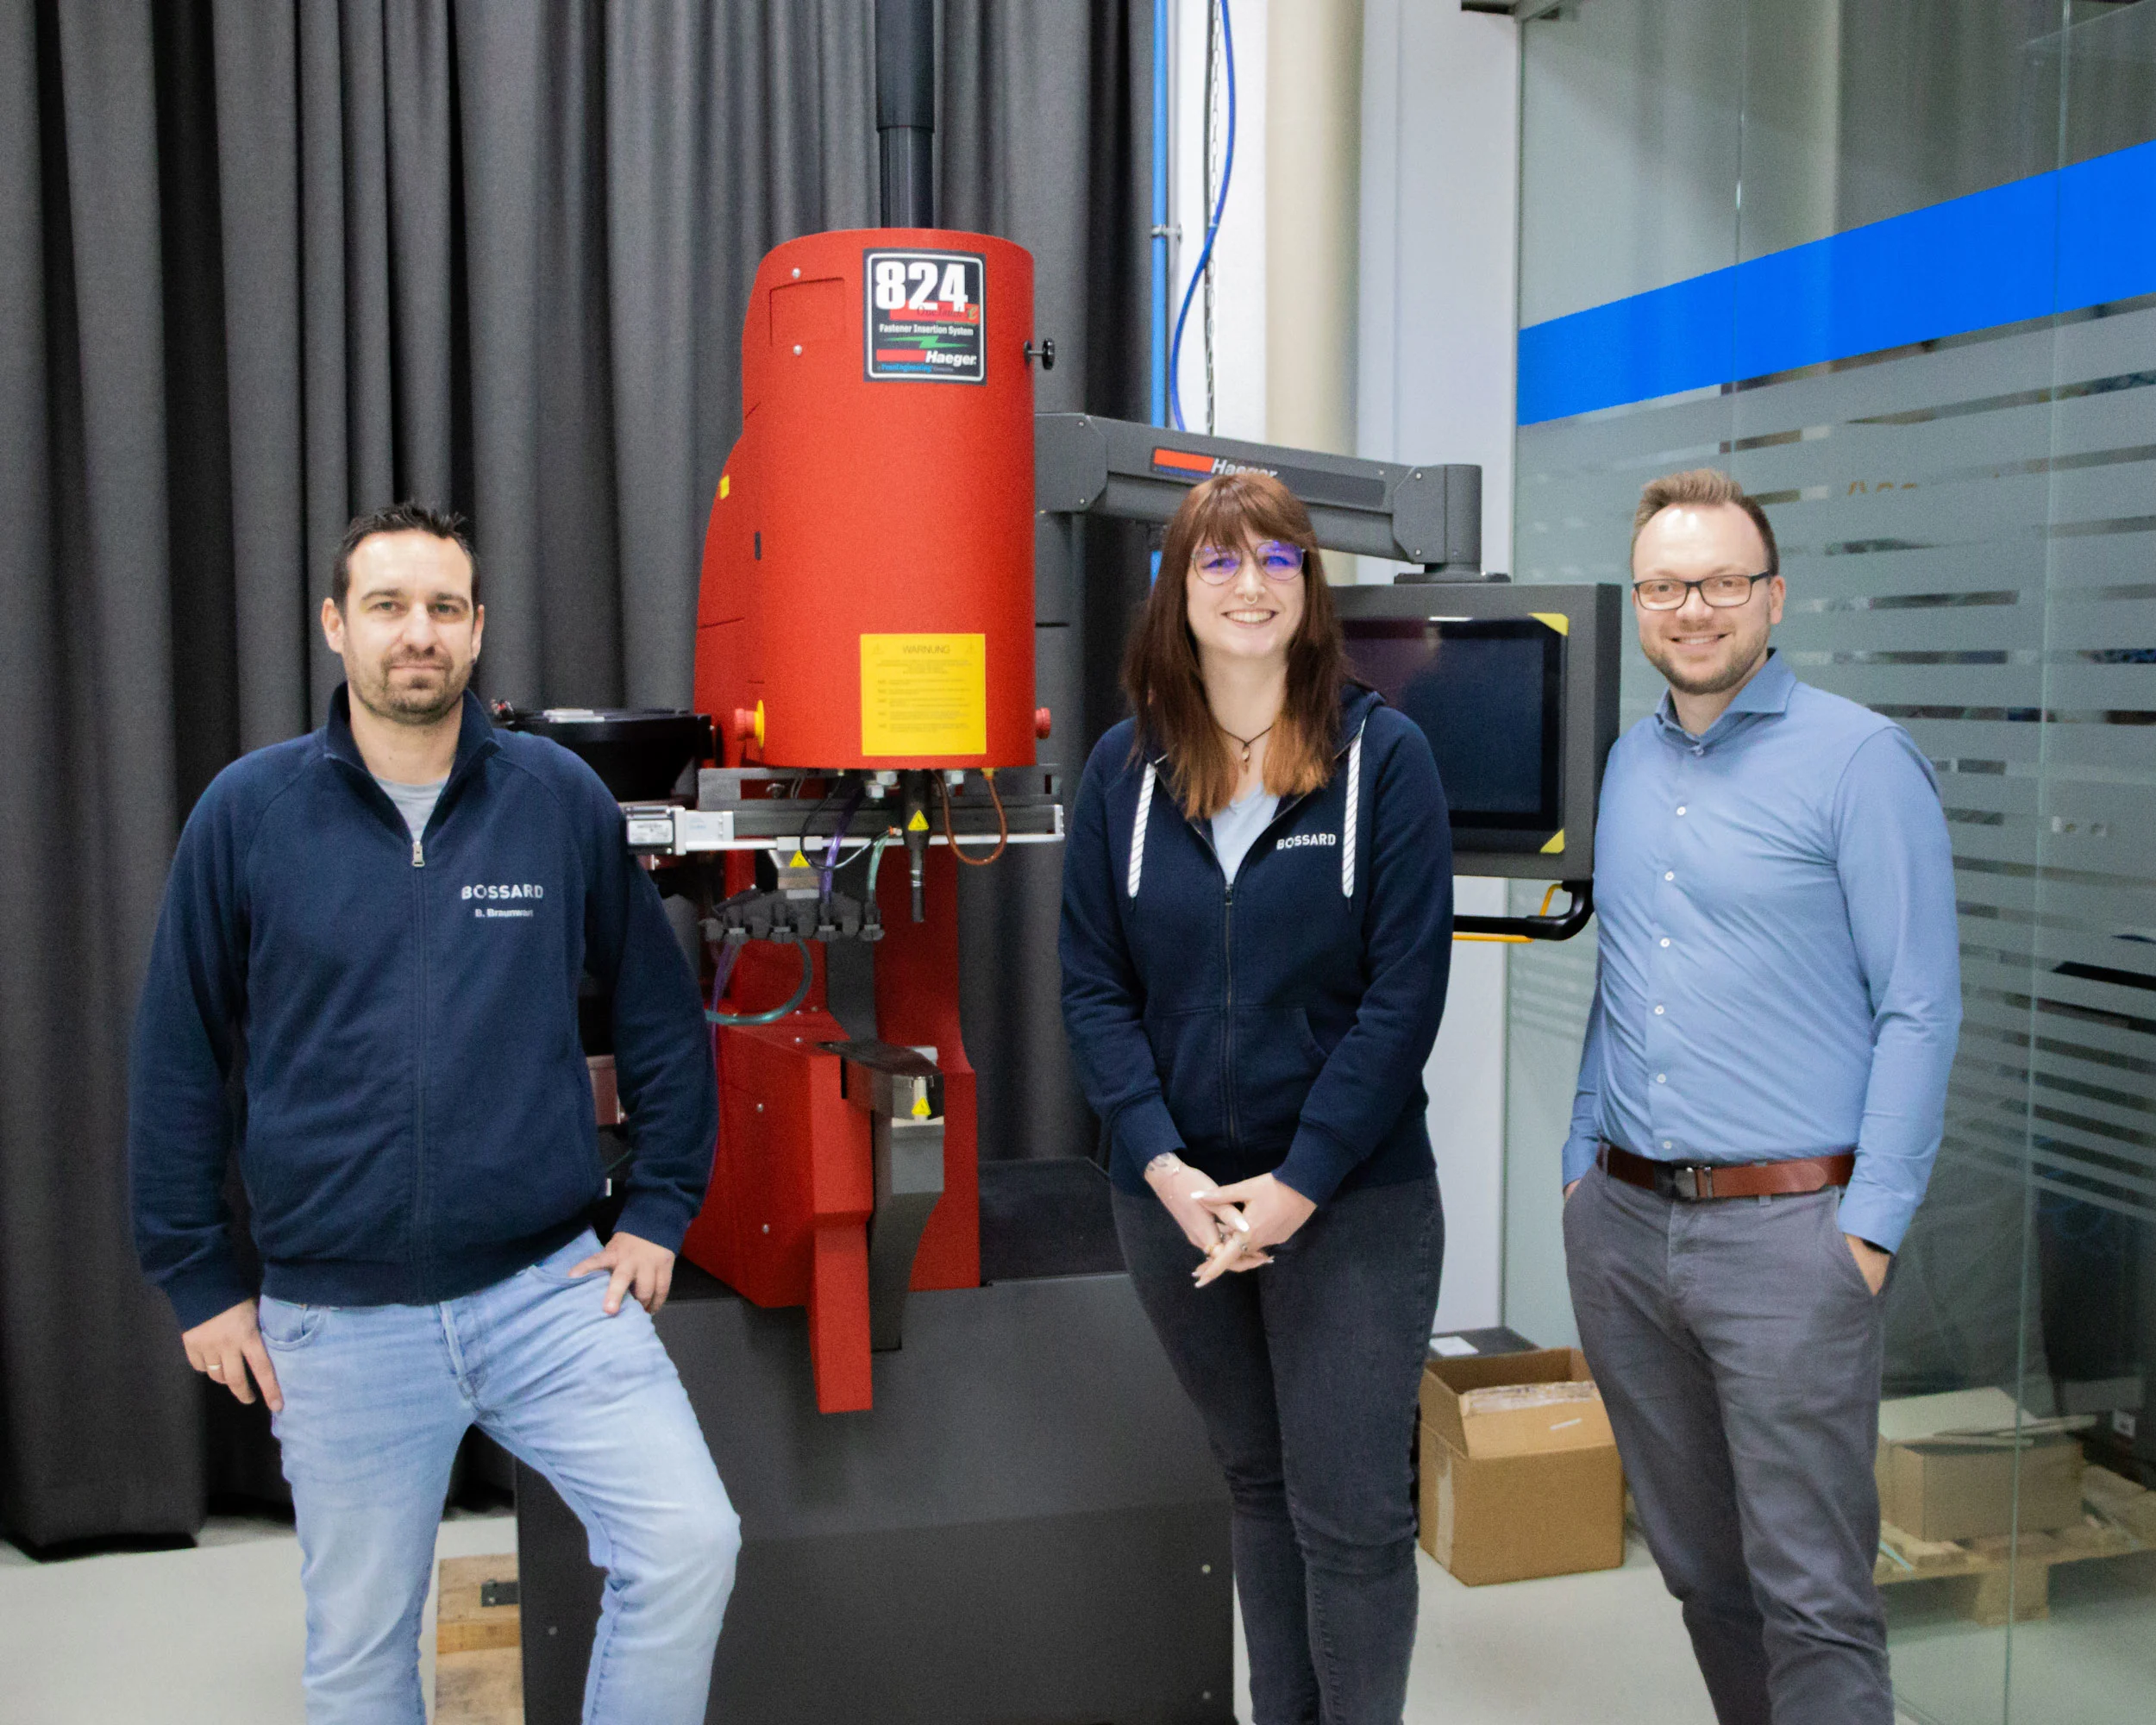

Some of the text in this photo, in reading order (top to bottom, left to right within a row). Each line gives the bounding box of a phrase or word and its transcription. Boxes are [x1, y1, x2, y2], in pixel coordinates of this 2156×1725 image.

[875, 260, 968, 312] 824
[879, 323, 975, 337] Fastener Insertion System
[924, 350, 975, 366] Haeger
[902, 644, 950, 655] WARNUNG
[1276, 833, 1337, 850] BOSSARD
[461, 884, 544, 900] BOSSARD
[475, 908, 485, 918] B.
